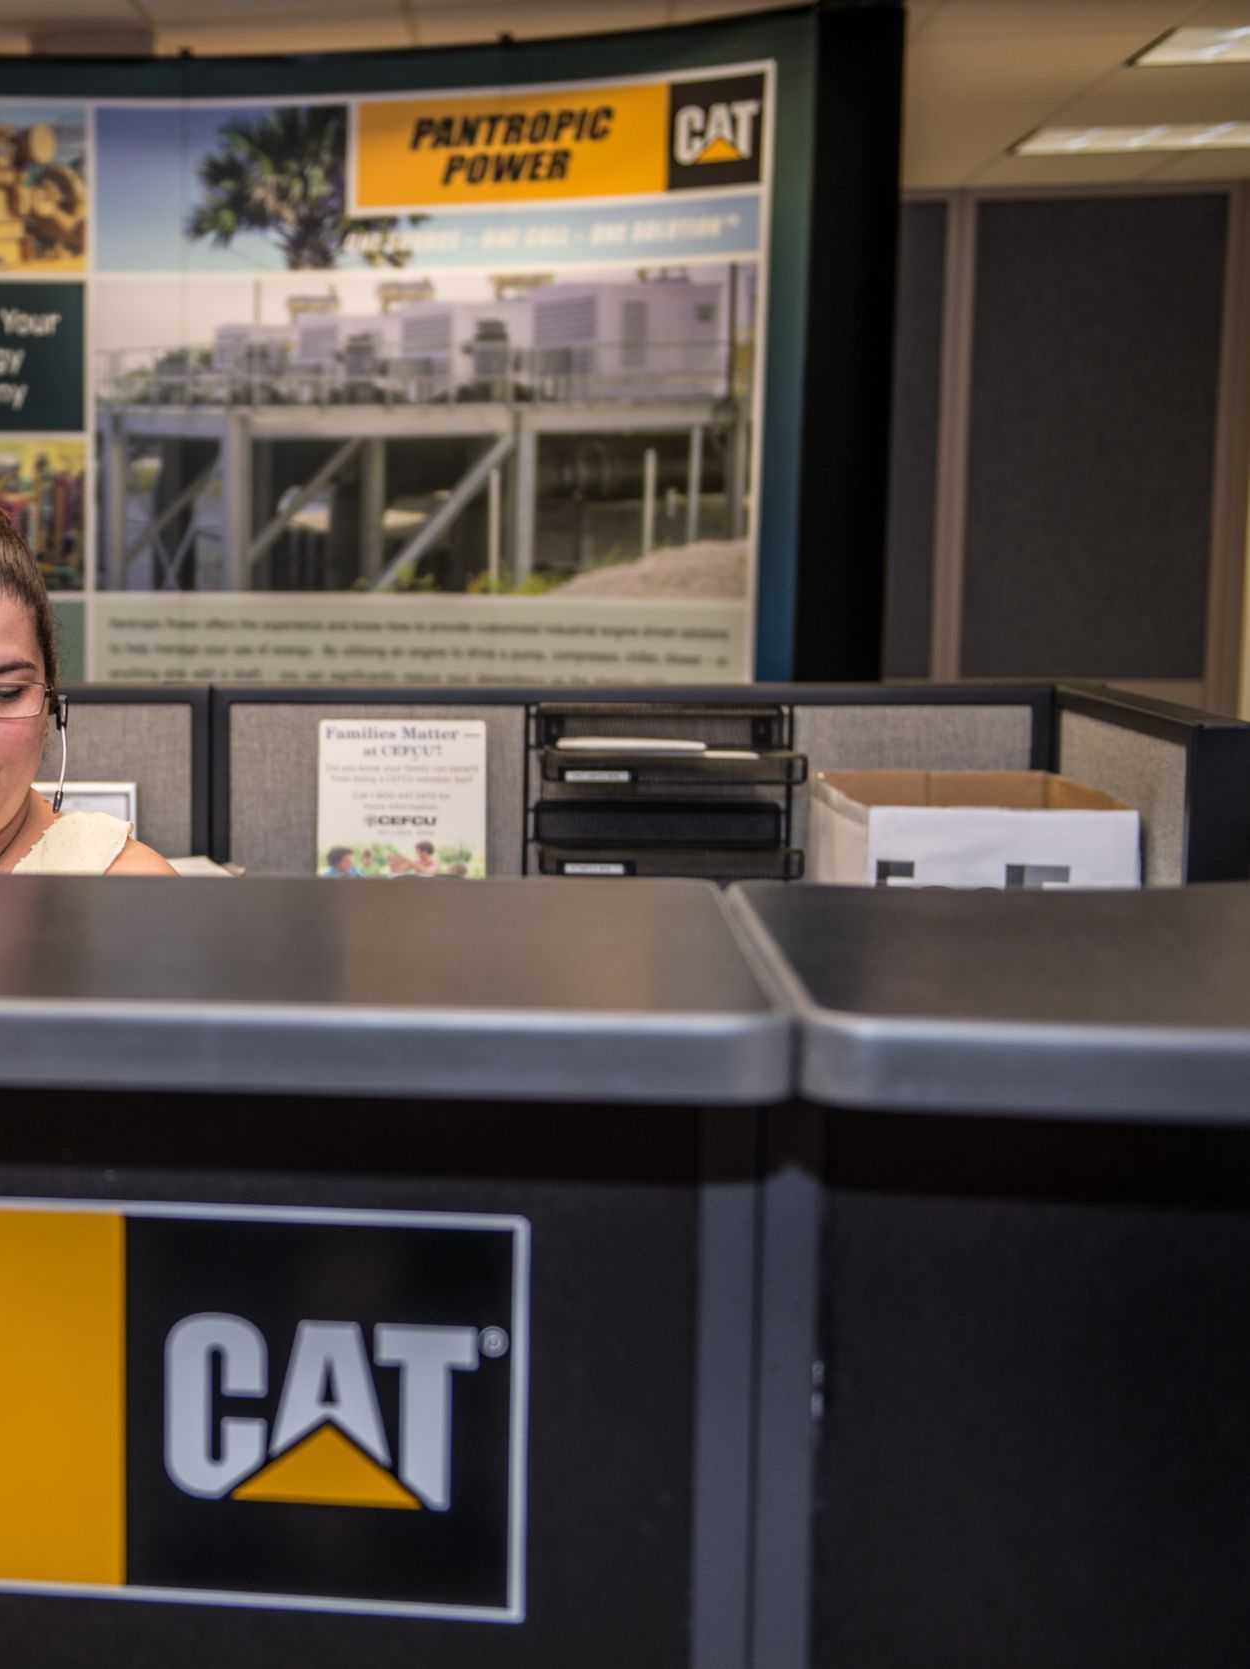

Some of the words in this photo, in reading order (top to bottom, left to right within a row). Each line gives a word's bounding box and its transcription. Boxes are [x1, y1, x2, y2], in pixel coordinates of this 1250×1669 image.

[411, 106, 614, 150] PANTROPIC
[674, 100, 761, 165] CAT
[442, 150, 570, 186] POWER
[482, 228, 518, 248] ONE
[525, 226, 569, 246] CALL
[589, 222, 627, 245] ONE
[0, 307, 62, 336] Your
[325, 726, 396, 741] Families
[402, 726, 459, 741] Matter
[363, 746, 377, 757] at
[378, 815, 437, 826] CEFCU
